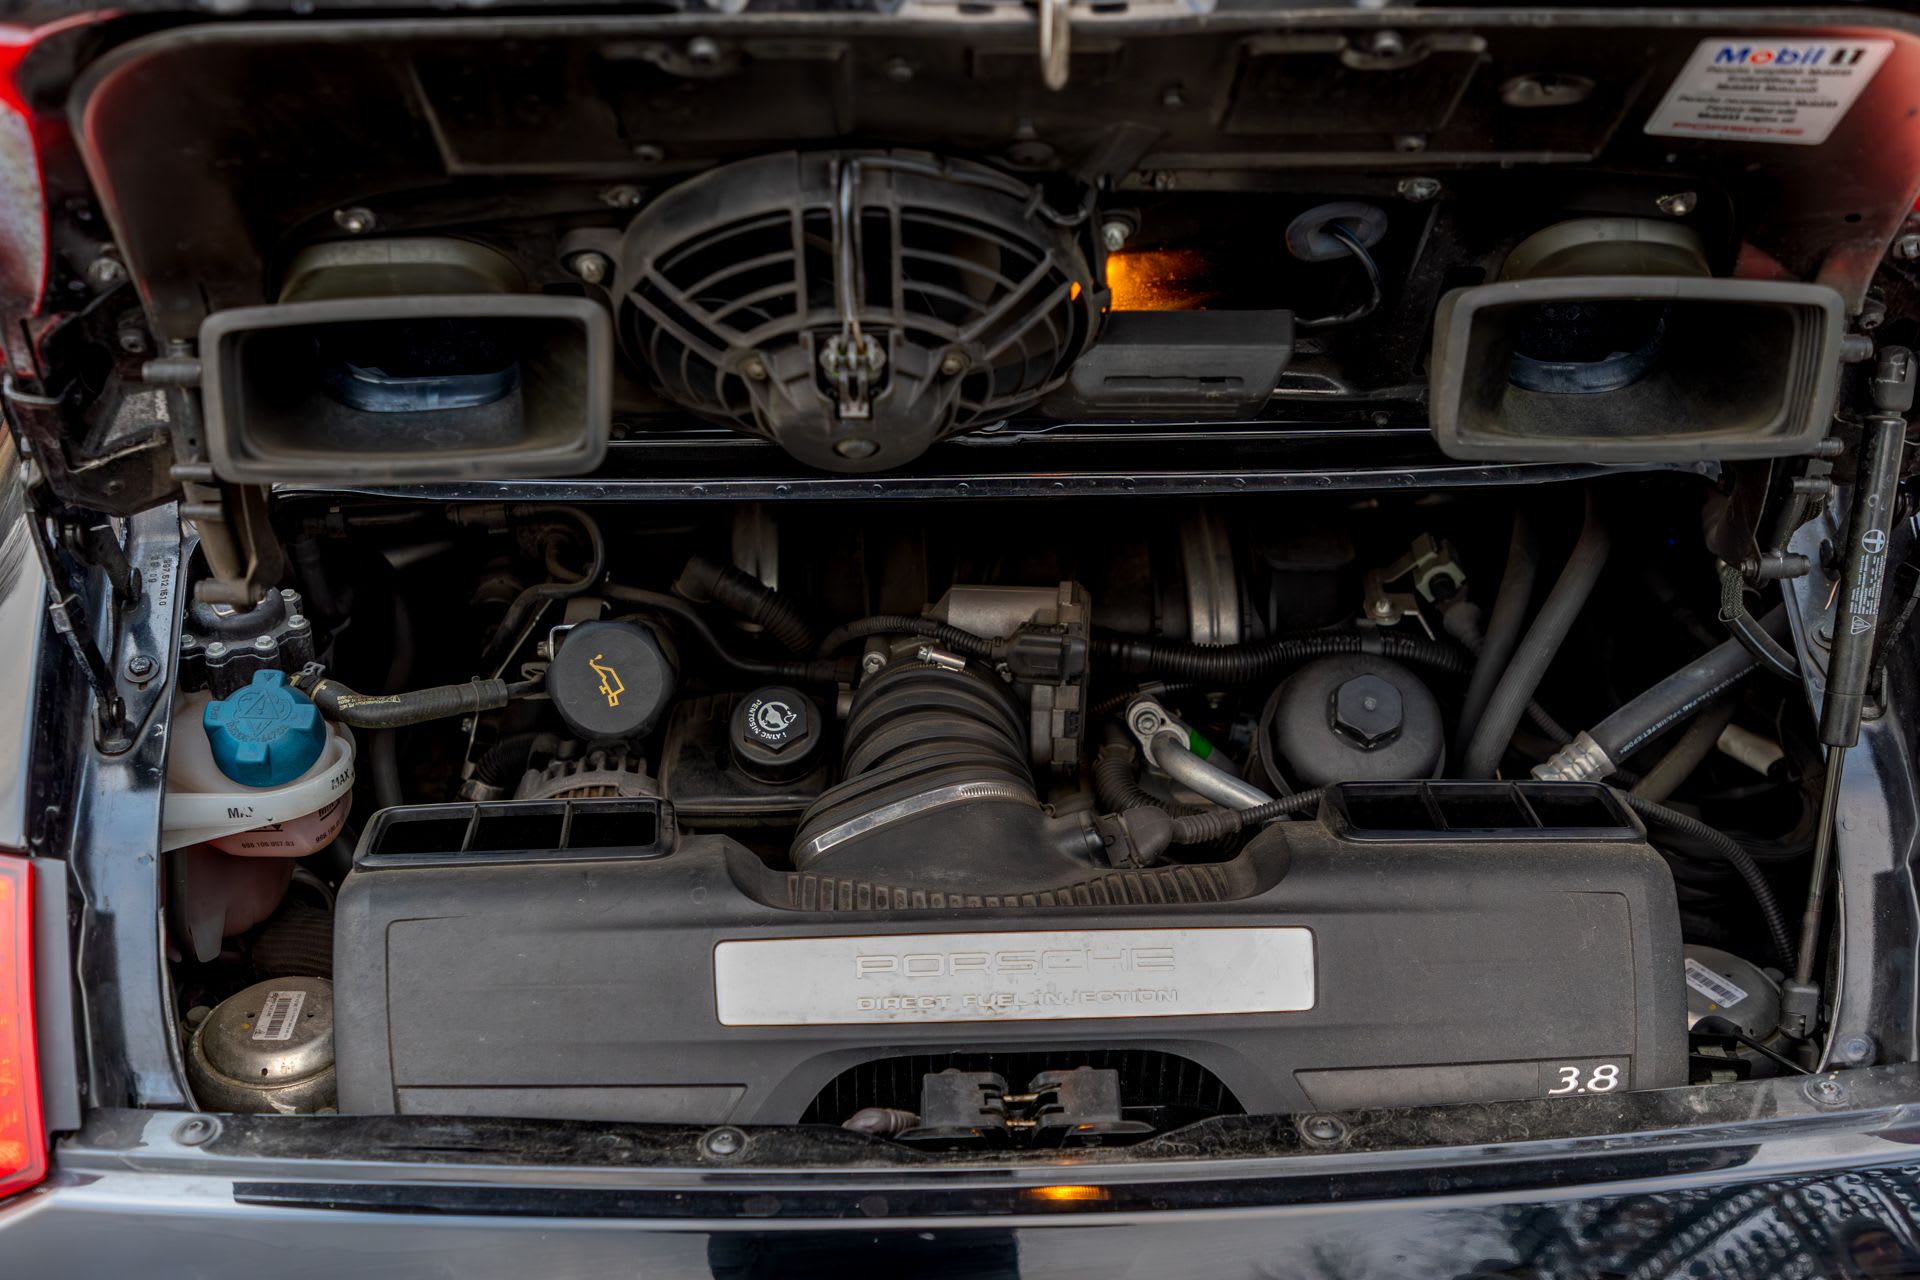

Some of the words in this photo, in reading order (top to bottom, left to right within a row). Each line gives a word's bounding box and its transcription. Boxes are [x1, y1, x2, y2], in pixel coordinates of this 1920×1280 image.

[1714, 47, 1826, 65] Mobil
[748, 699, 763, 735] PENTOSIN
[761, 732, 781, 740] ONLY
[855, 947, 1176, 979] PORSCHE
[856, 994, 952, 1011] DIRECT
[962, 991, 1027, 1008] FUEL
[1034, 988, 1179, 1007] INJECTION
[1548, 1064, 1619, 1095] 3.8
